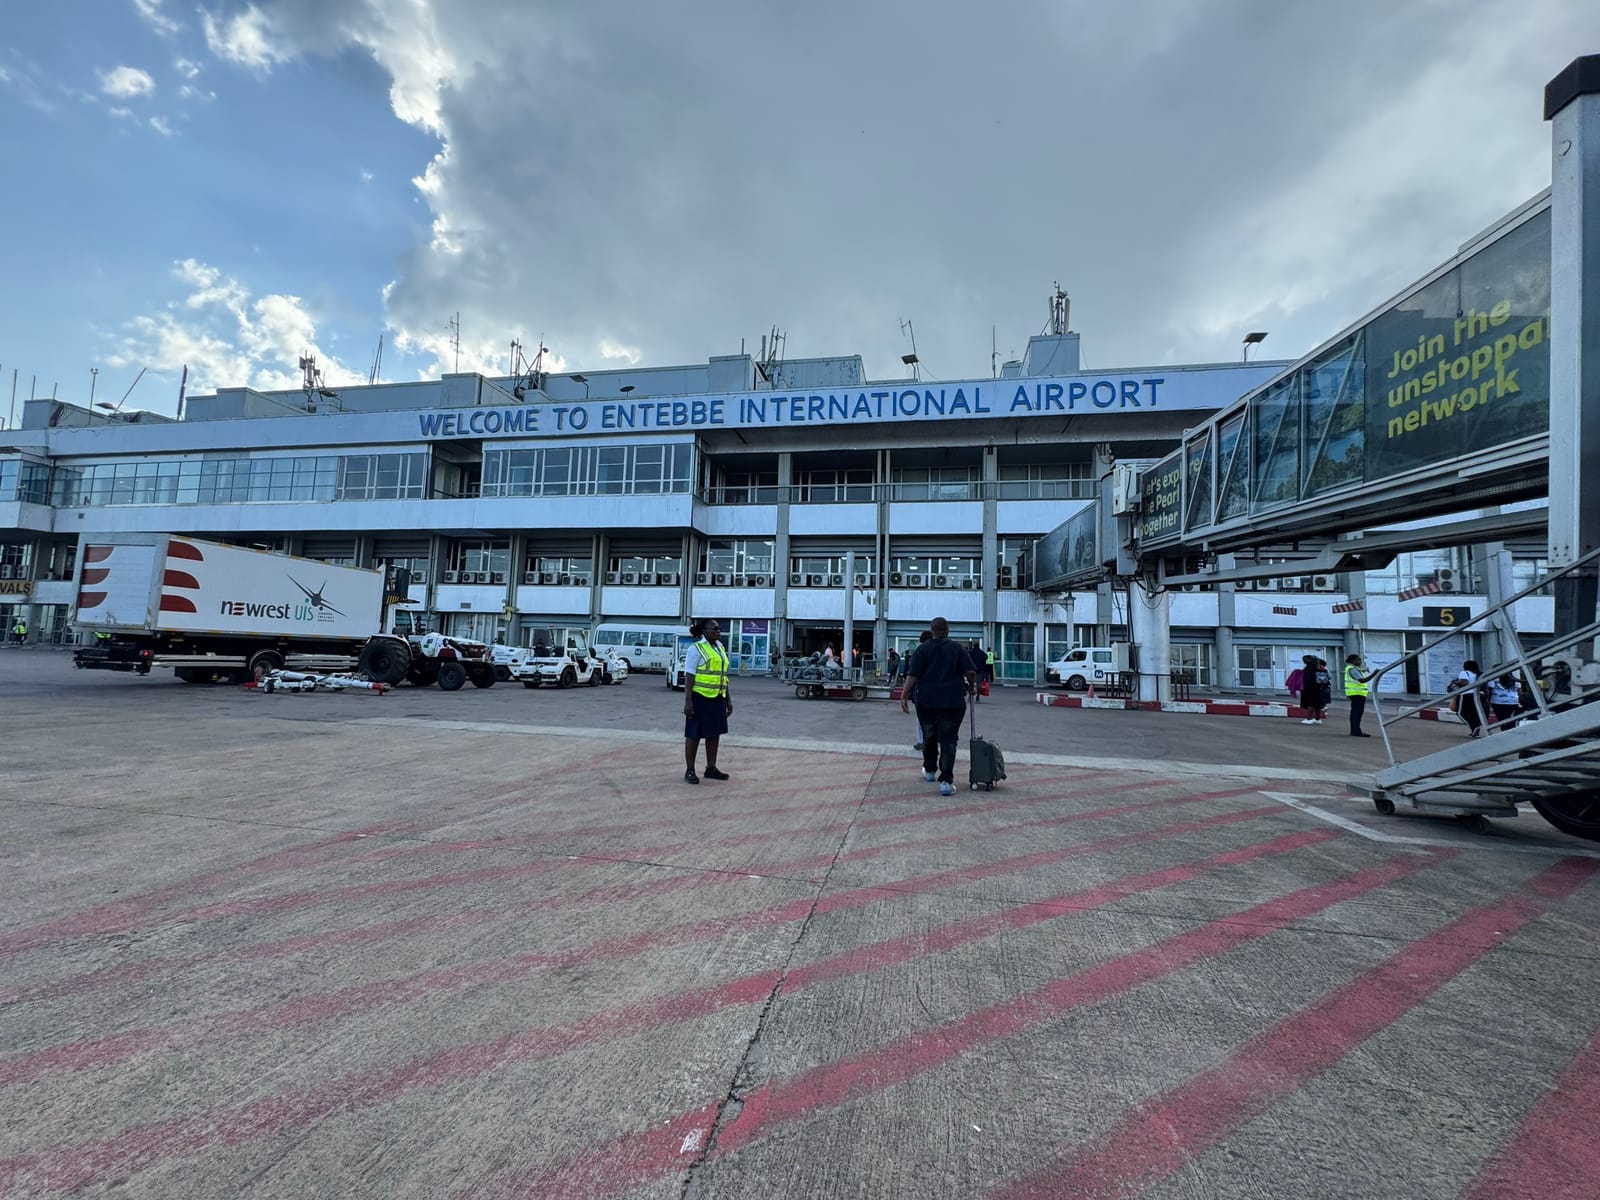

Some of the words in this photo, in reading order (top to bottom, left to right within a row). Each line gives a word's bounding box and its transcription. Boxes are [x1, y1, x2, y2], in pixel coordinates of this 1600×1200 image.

[1387, 333, 1445, 379] Join
[1454, 299, 1511, 346] the
[1388, 306, 1550, 408] unstoppa
[419, 408, 540, 436] WELCOME
[553, 406, 588, 430] TO
[602, 400, 724, 428] ENTEBBE
[739, 386, 991, 423] INTERNATIONAL
[1009, 378, 1165, 412] AIRPORT
[1388, 367, 1520, 438] network
[1162, 457, 1201, 488] explre
[1156, 484, 1180, 511] Pearl
[221, 600, 291, 620] newrest
[1440, 608, 1454, 626] 5
